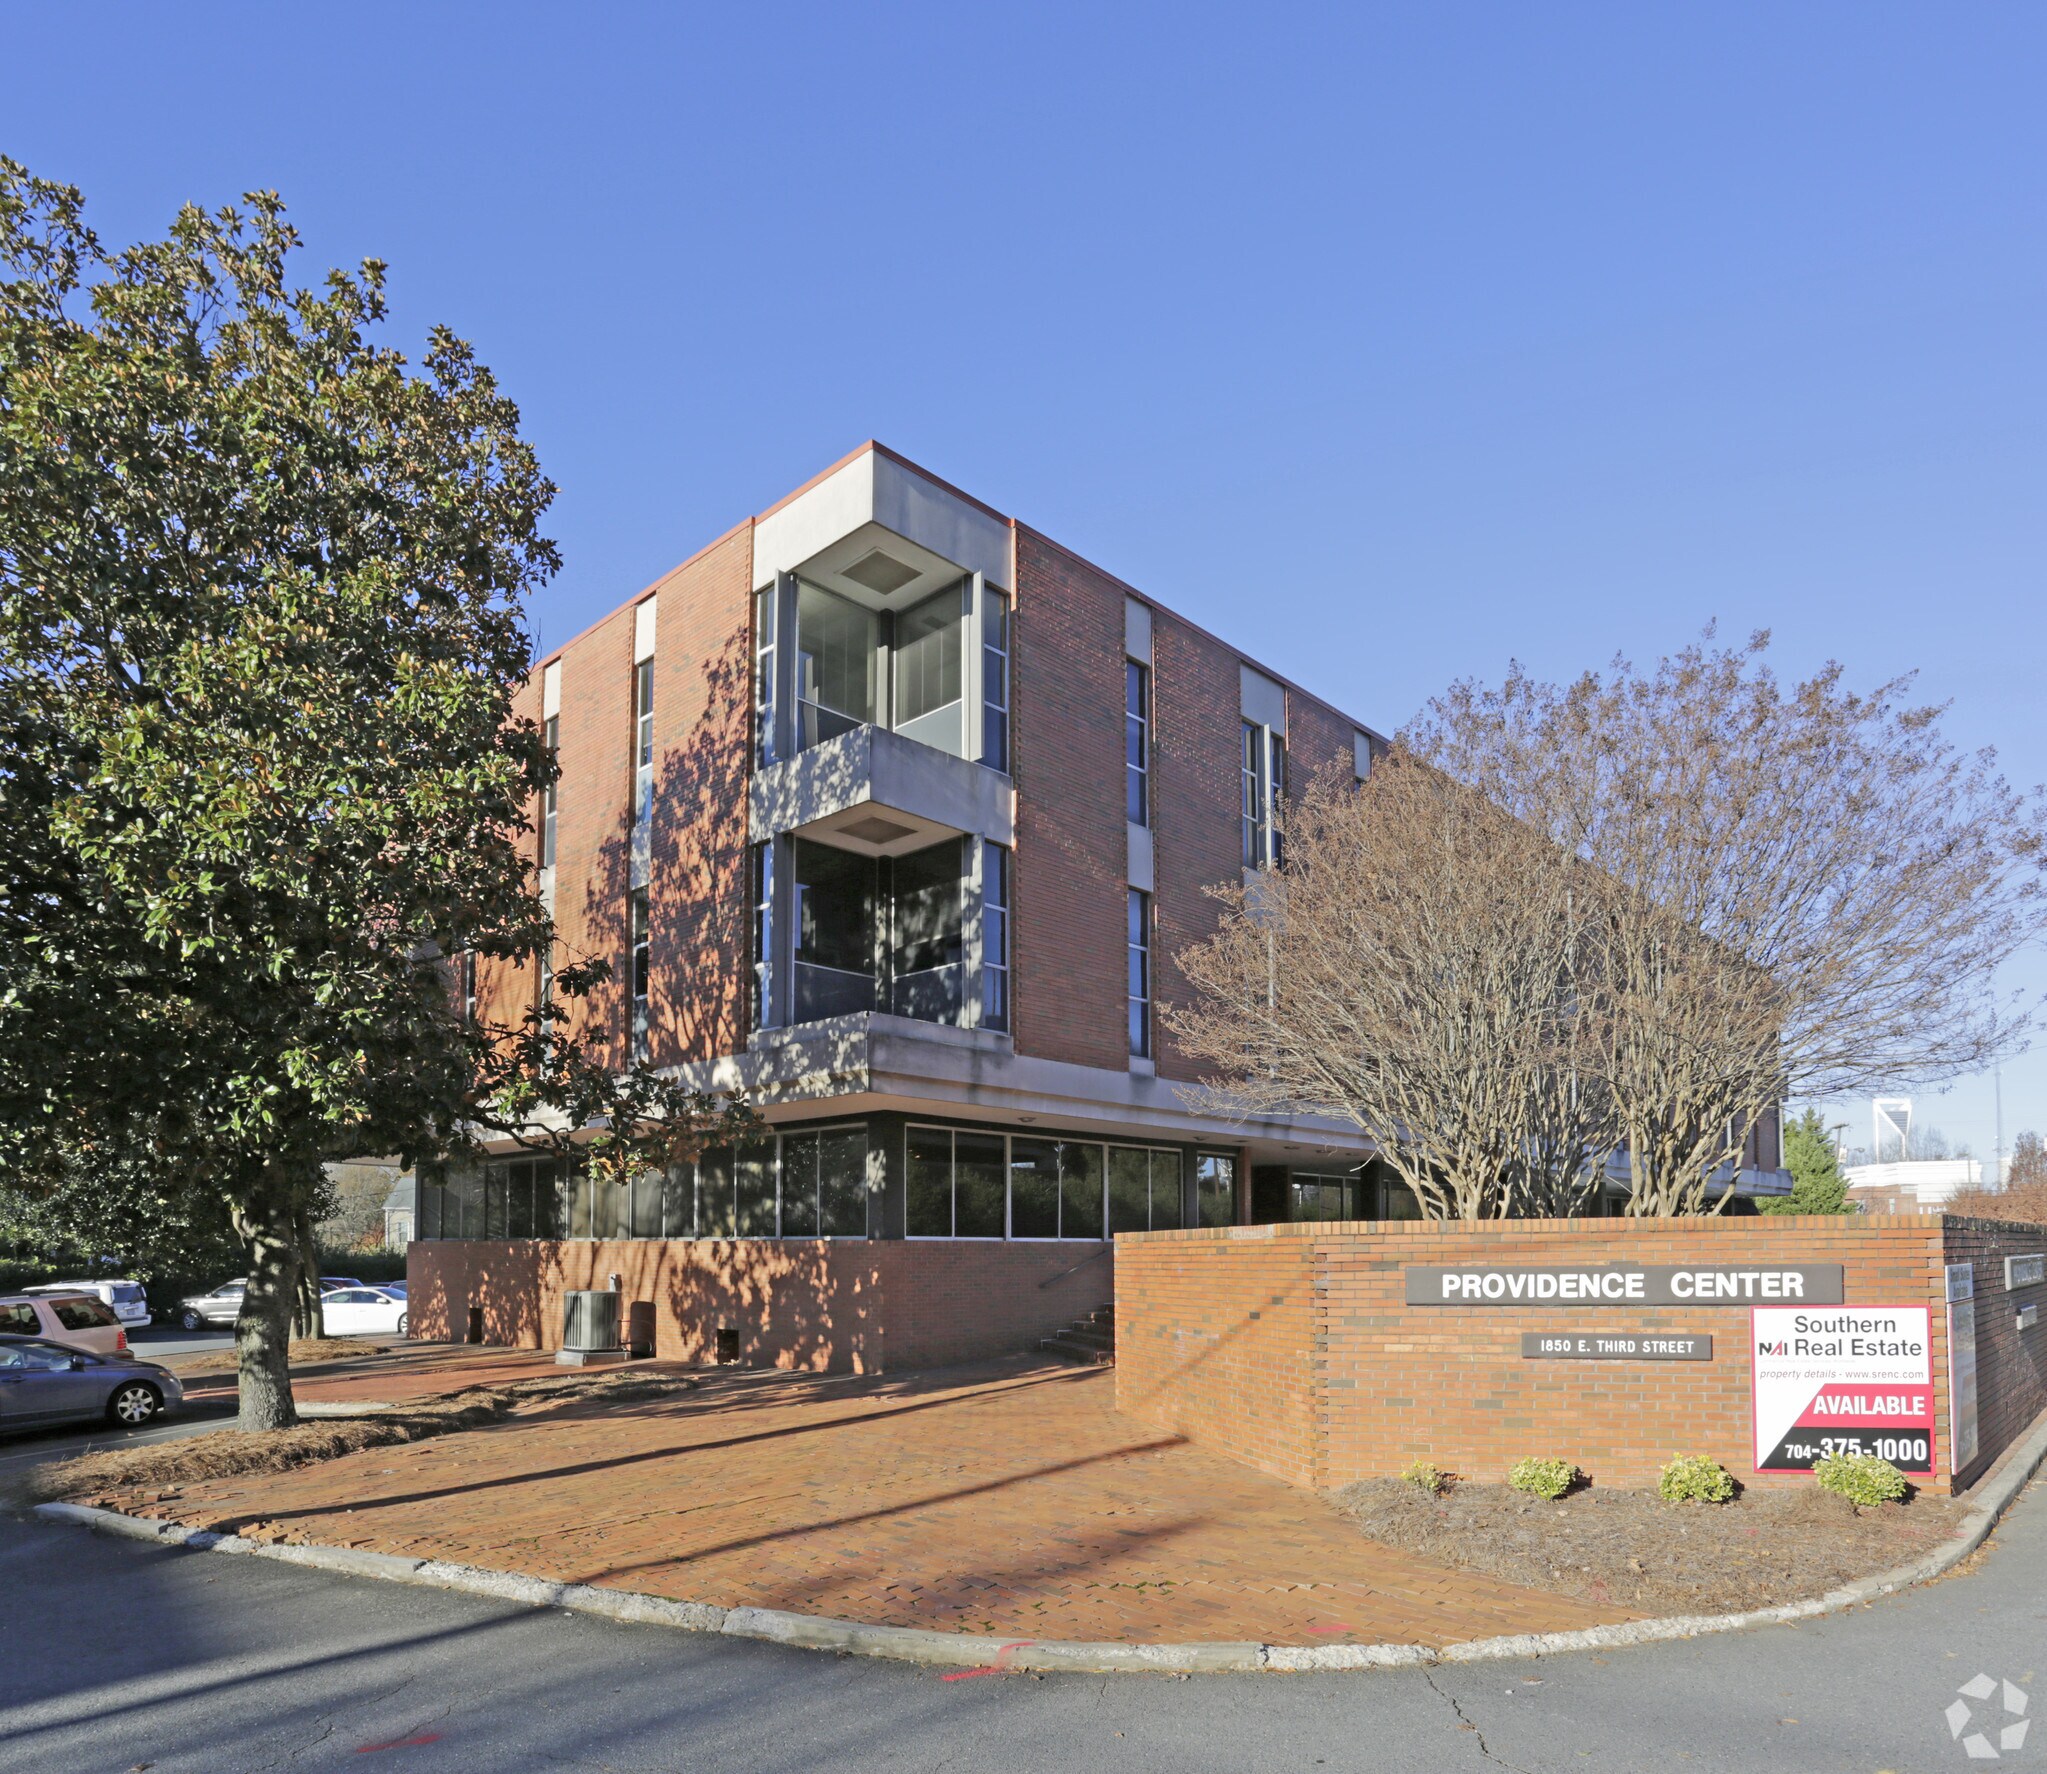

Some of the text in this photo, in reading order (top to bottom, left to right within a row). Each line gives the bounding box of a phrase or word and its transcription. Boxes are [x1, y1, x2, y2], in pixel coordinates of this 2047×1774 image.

[1442, 1271, 1804, 1298] PROVIDENCE CENTER
[1794, 1315, 1897, 1333] Southern
[1540, 1339, 1695, 1354] 1850 E. THIRD STREET
[1758, 1340, 1788, 1356] NAI
[1795, 1338, 1922, 1356] Real Estate
[1759, 1370, 1801, 1380] property
[1804, 1369, 1837, 1379] details
[1845, 1370, 1924, 1379] www.srenc.com
[1813, 1396, 1925, 1416] AVAILABLE
[1785, 1437, 1927, 1461] 704-375-1000
